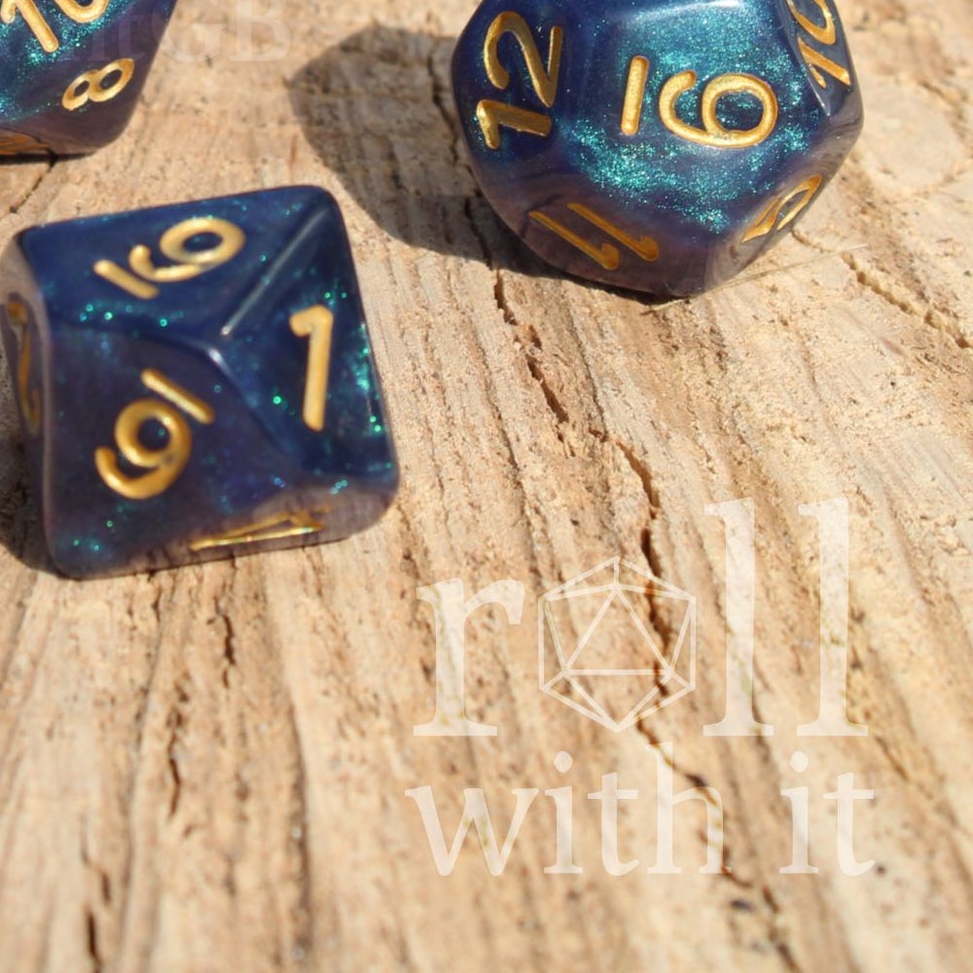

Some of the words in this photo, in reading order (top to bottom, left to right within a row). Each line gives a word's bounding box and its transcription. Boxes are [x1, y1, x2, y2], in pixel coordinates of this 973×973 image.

[61, 57, 135, 111] 8
[475, 11, 563, 149] 12
[528, 202, 660, 270] 11
[289, 304, 334, 431] 1
